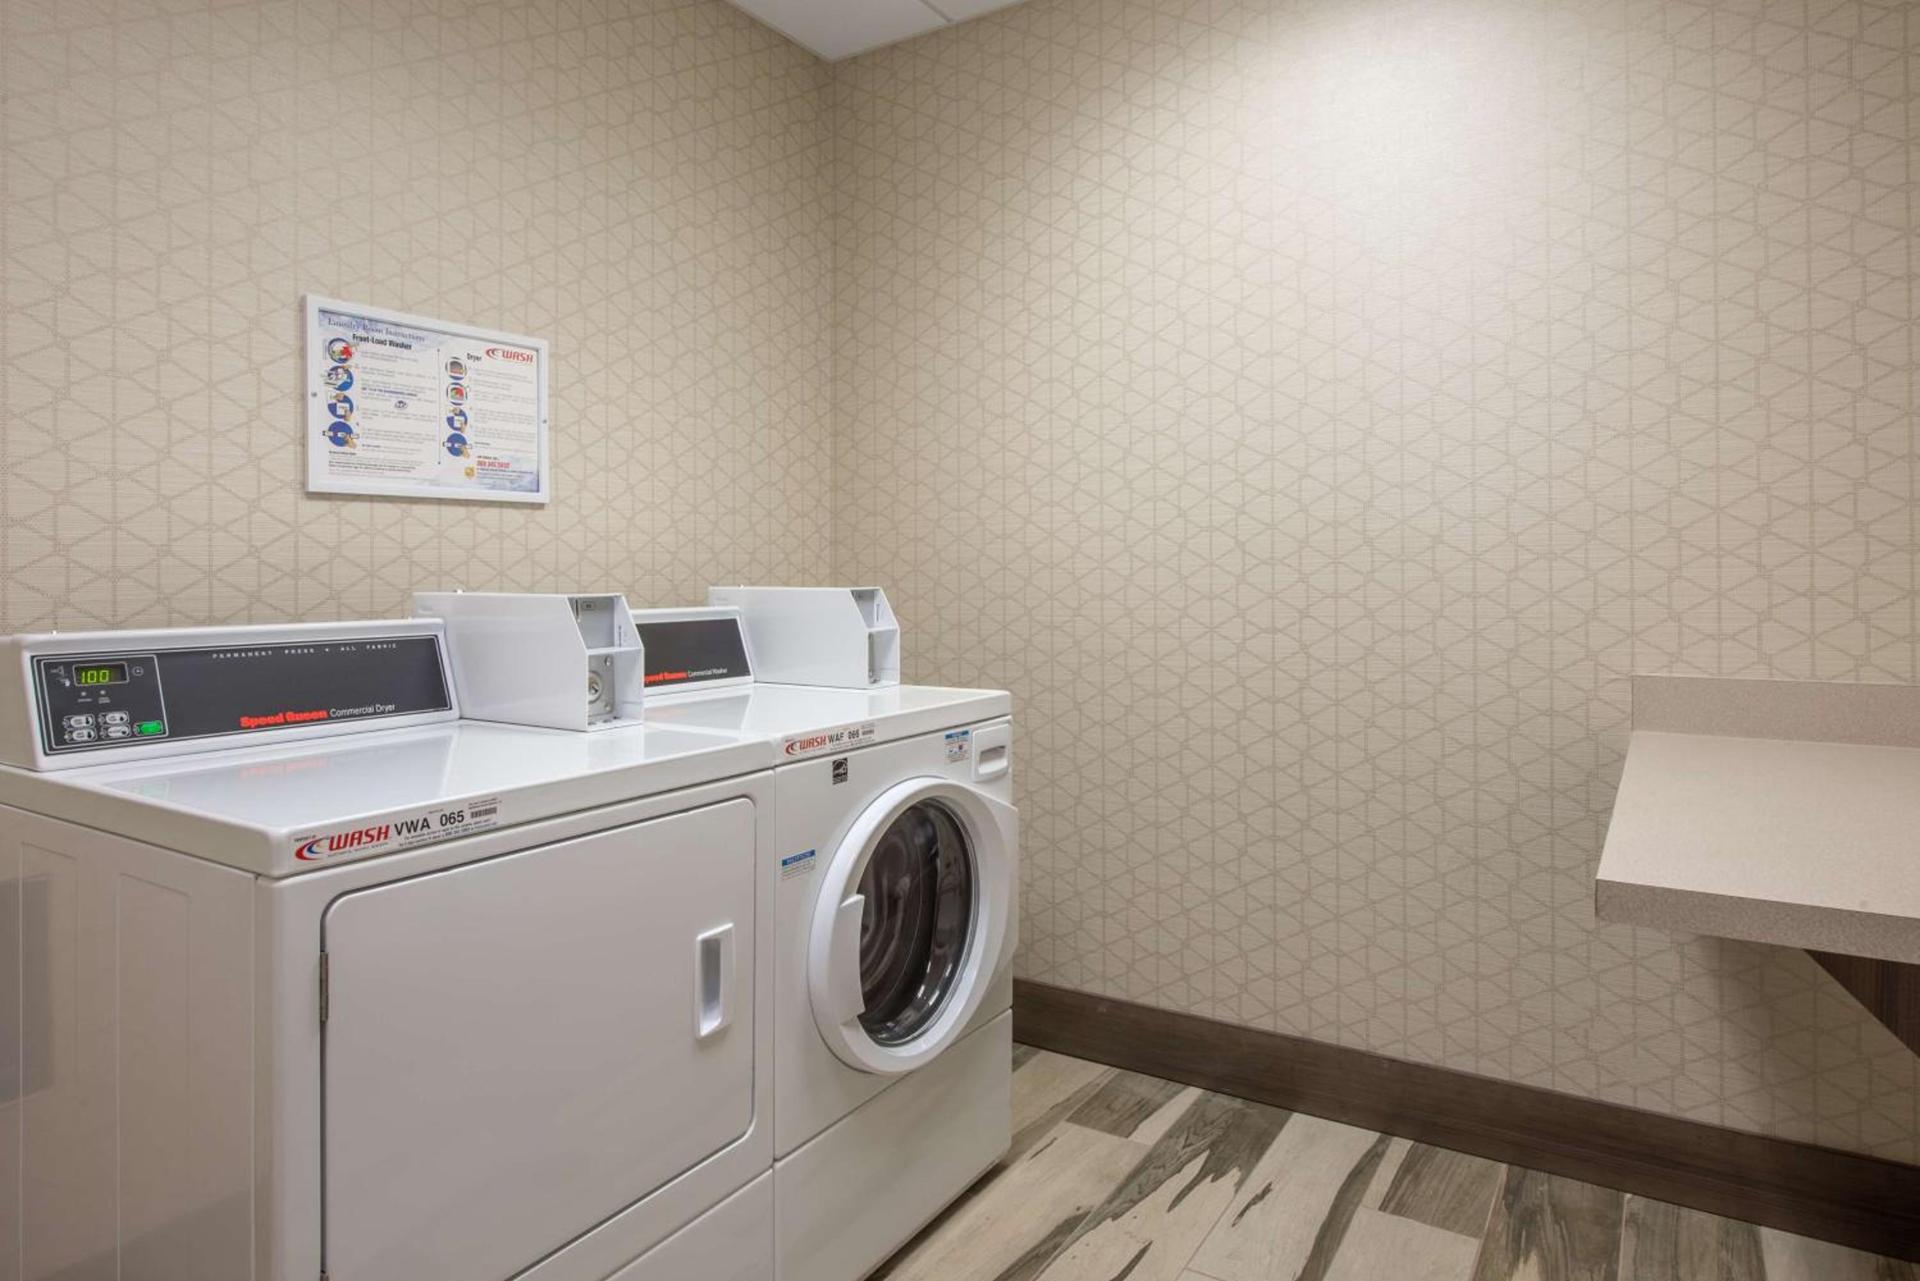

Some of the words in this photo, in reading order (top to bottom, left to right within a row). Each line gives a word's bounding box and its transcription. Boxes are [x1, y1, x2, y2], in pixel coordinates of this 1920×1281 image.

[467, 353, 482, 362] Dryer
[502, 349, 534, 363] WASH
[81, 669, 109, 684] 100
[240, 713, 284, 729] Speed
[285, 710, 328, 724] Queen
[329, 706, 375, 718] Commercial
[376, 703, 396, 713] Dryer
[800, 735, 827, 750] WASH
[328, 825, 390, 851] WASH
[394, 817, 431, 836] VWA
[440, 810, 465, 827] 065
